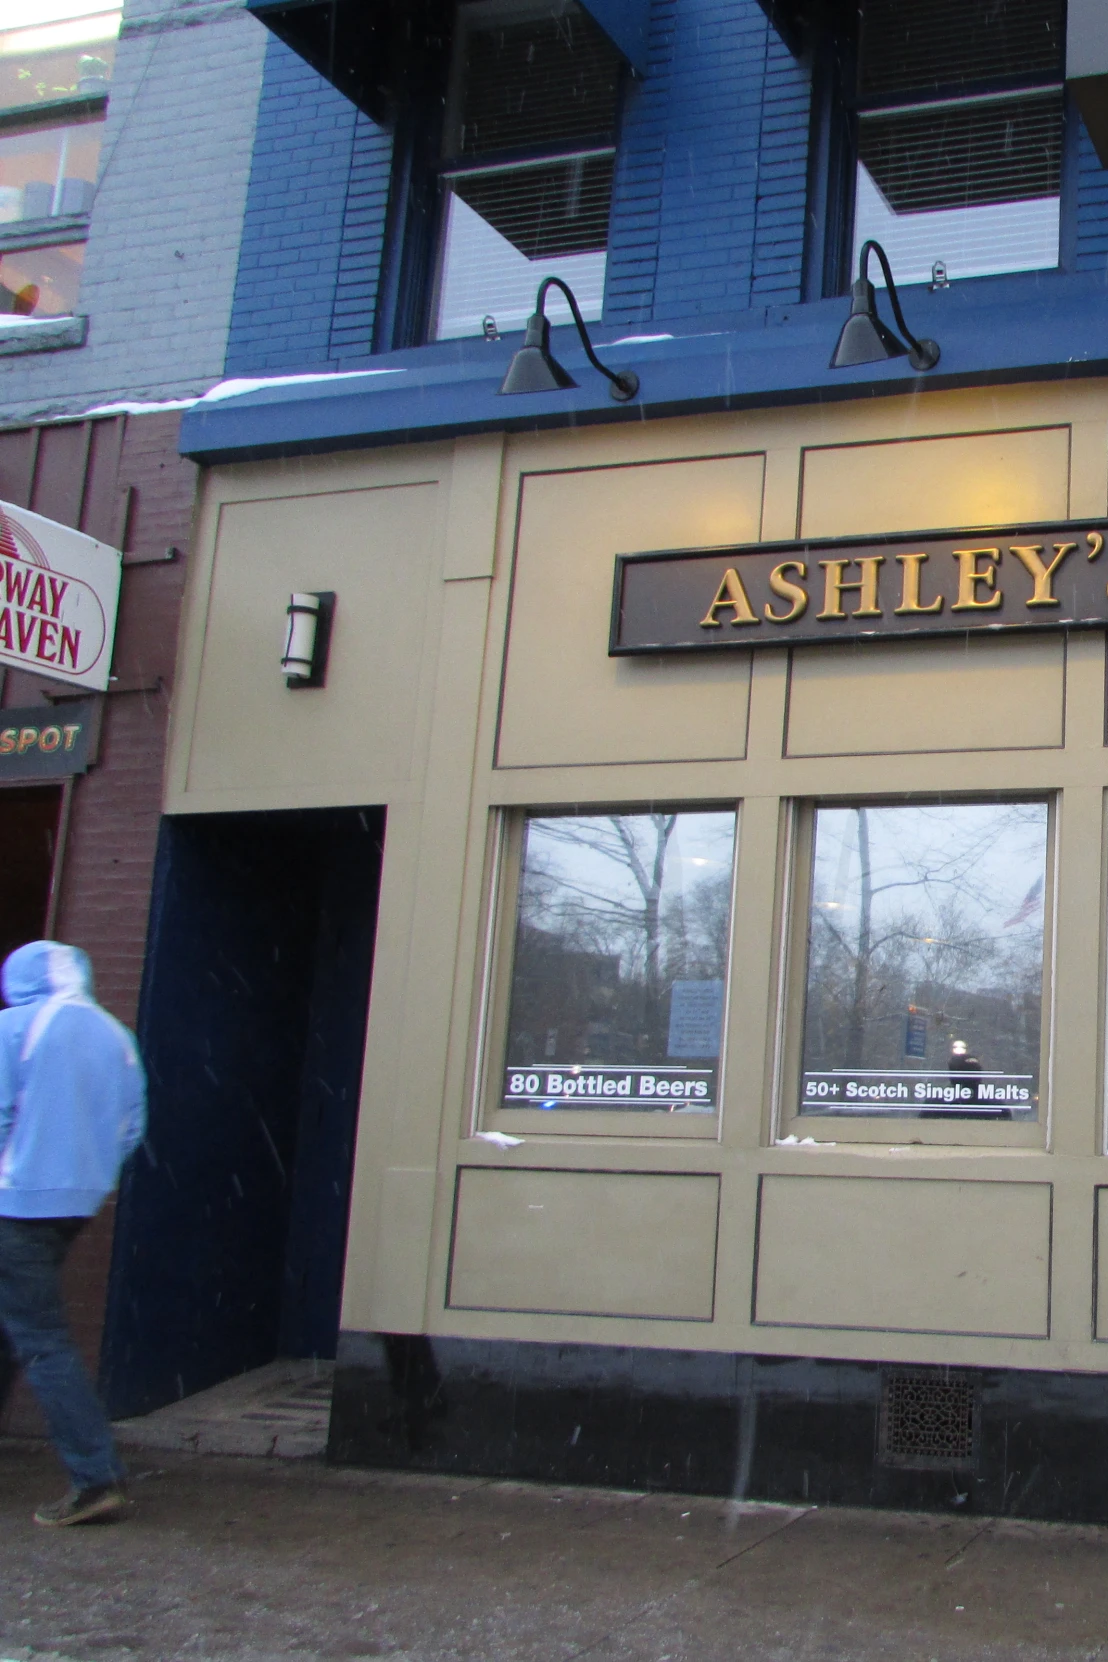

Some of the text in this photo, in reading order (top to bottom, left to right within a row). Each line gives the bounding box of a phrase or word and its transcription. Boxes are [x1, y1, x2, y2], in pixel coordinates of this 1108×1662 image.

[0, 724, 81, 753] SPOT
[509, 1073, 708, 1096] 80 Bottled Beers
[806, 1081, 1029, 1101] 50+ Scotch Single Malts
